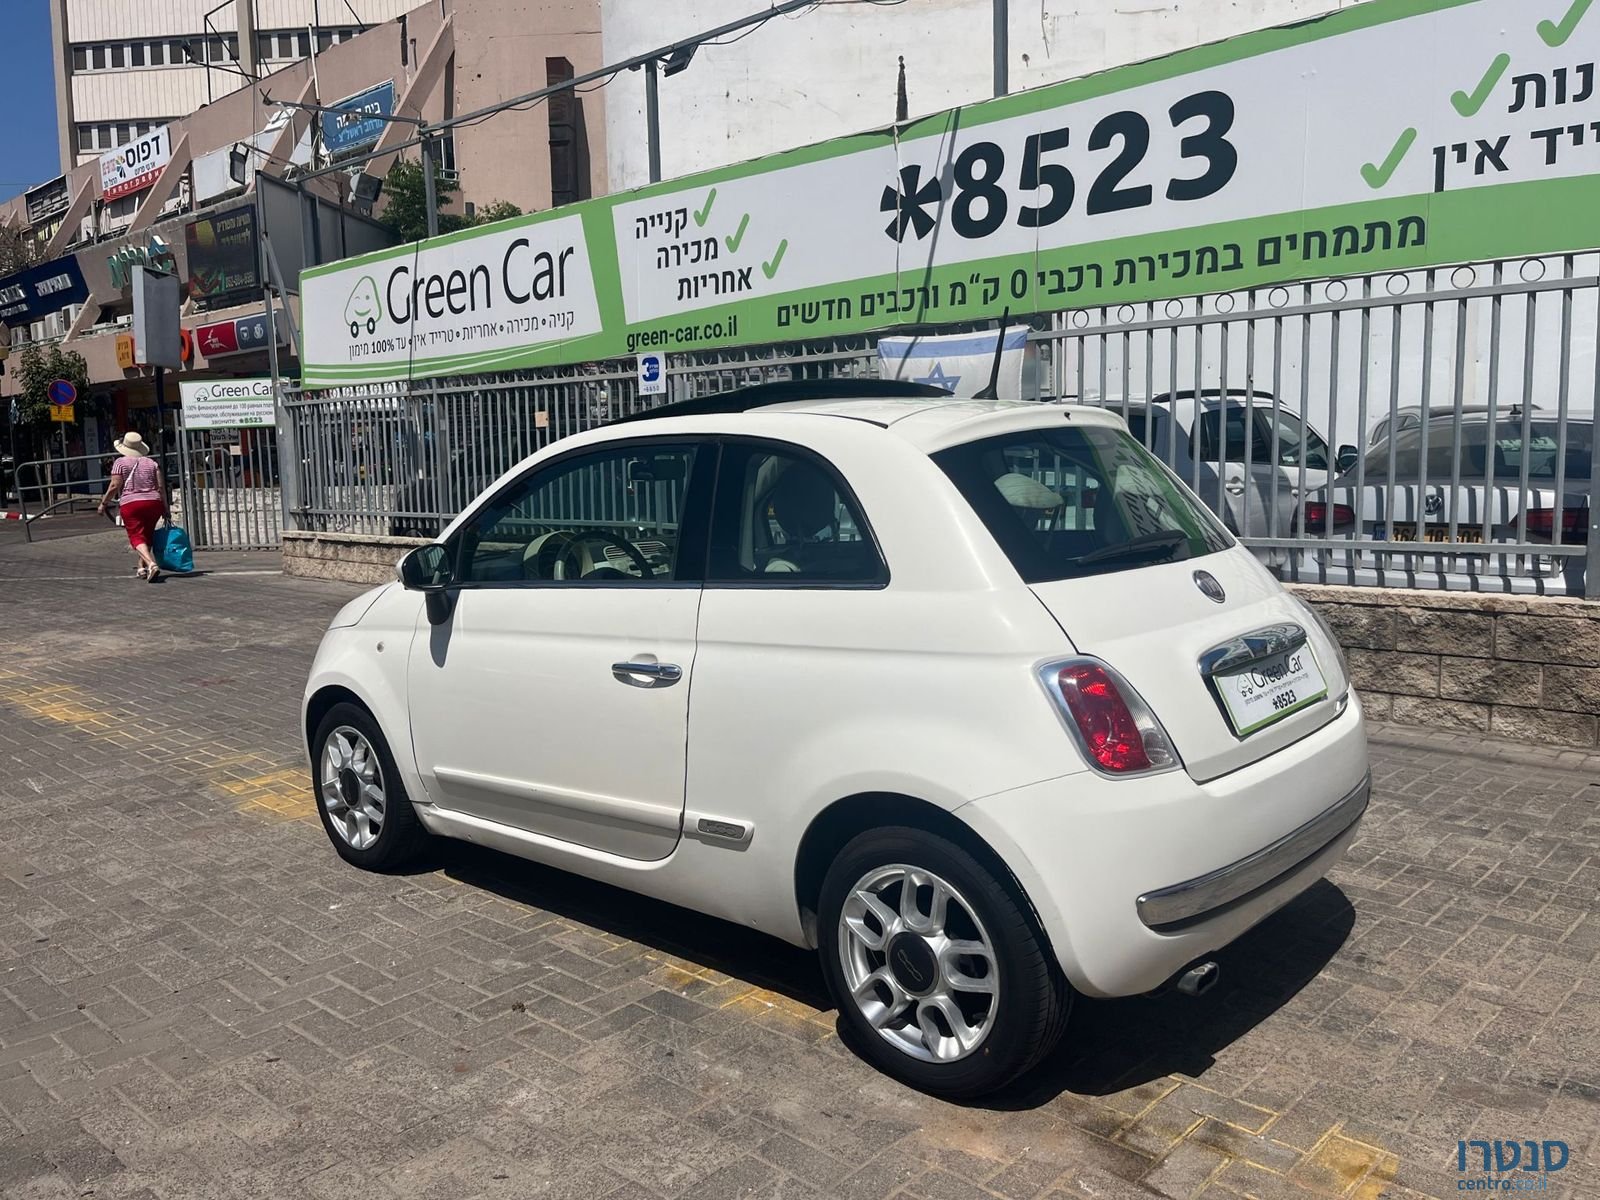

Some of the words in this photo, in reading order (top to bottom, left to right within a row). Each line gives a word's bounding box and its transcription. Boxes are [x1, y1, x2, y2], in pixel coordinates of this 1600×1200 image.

[1508, 62, 1598, 113] נות
[125, 135, 160, 168] דפוס
[1530, 121, 1600, 165] ייד
[1432, 135, 1511, 193] אין
[635, 207, 688, 239] קנייה
[657, 237, 718, 269] מכירה
[1257, 215, 1426, 267] מתמחים
[1037, 263, 1103, 294] רכבי
[1113, 243, 1244, 286] במכירת
[386, 264, 492, 325] Green
[502, 238, 574, 305] Car
[677, 266, 753, 301] אחריות
[1010, 268, 1028, 299] 0
[777, 297, 851, 328] חדשים
[860, 285, 939, 317] ורכבים
[429, 329, 454, 344] טרייד
[462, 322, 498, 340] אחריות
[507, 316, 539, 334] מכירה
[549, 311, 574, 331] קניה
[626, 315, 738, 352] green-car.co.il
[349, 343, 369, 360] מימון
[371, 339, 395, 354] 100%
[395, 337, 407, 350] עד
[413, 333, 427, 351] אין
[211, 384, 250, 397] Green
[252, 382, 273, 396] Car
[1251, 663, 1288, 688] Green
[1284, 654, 1303, 674] Car
